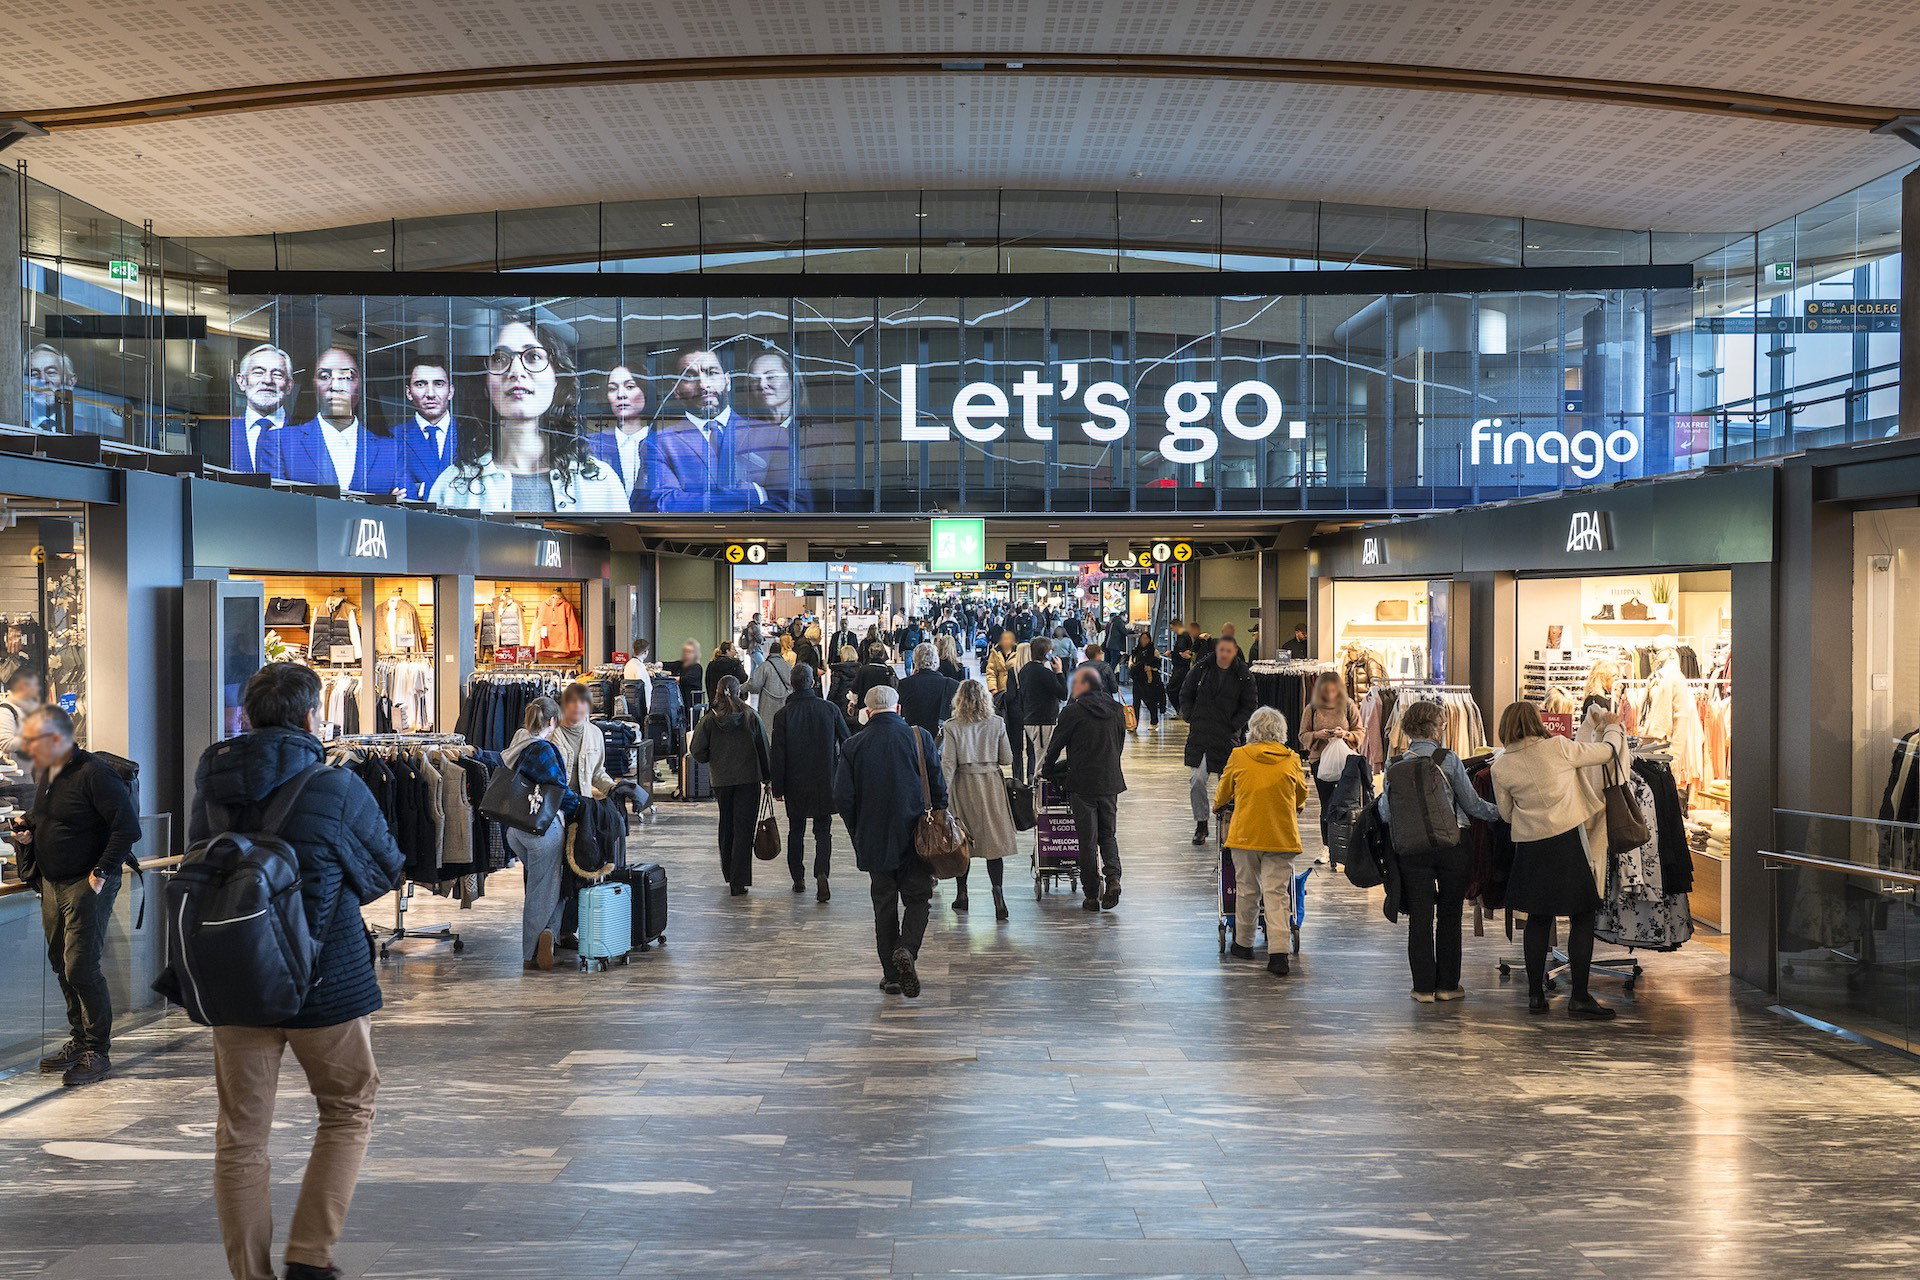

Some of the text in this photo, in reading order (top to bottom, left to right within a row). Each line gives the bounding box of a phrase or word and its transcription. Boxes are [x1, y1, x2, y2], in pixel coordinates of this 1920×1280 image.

[1840, 304, 1897, 315] A,BC,D,E,F,G
[1158, 380, 1307, 464] go.
[1471, 418, 1639, 480] finago
[1147, 580, 1158, 590] A
[1542, 722, 1566, 732] 50%
